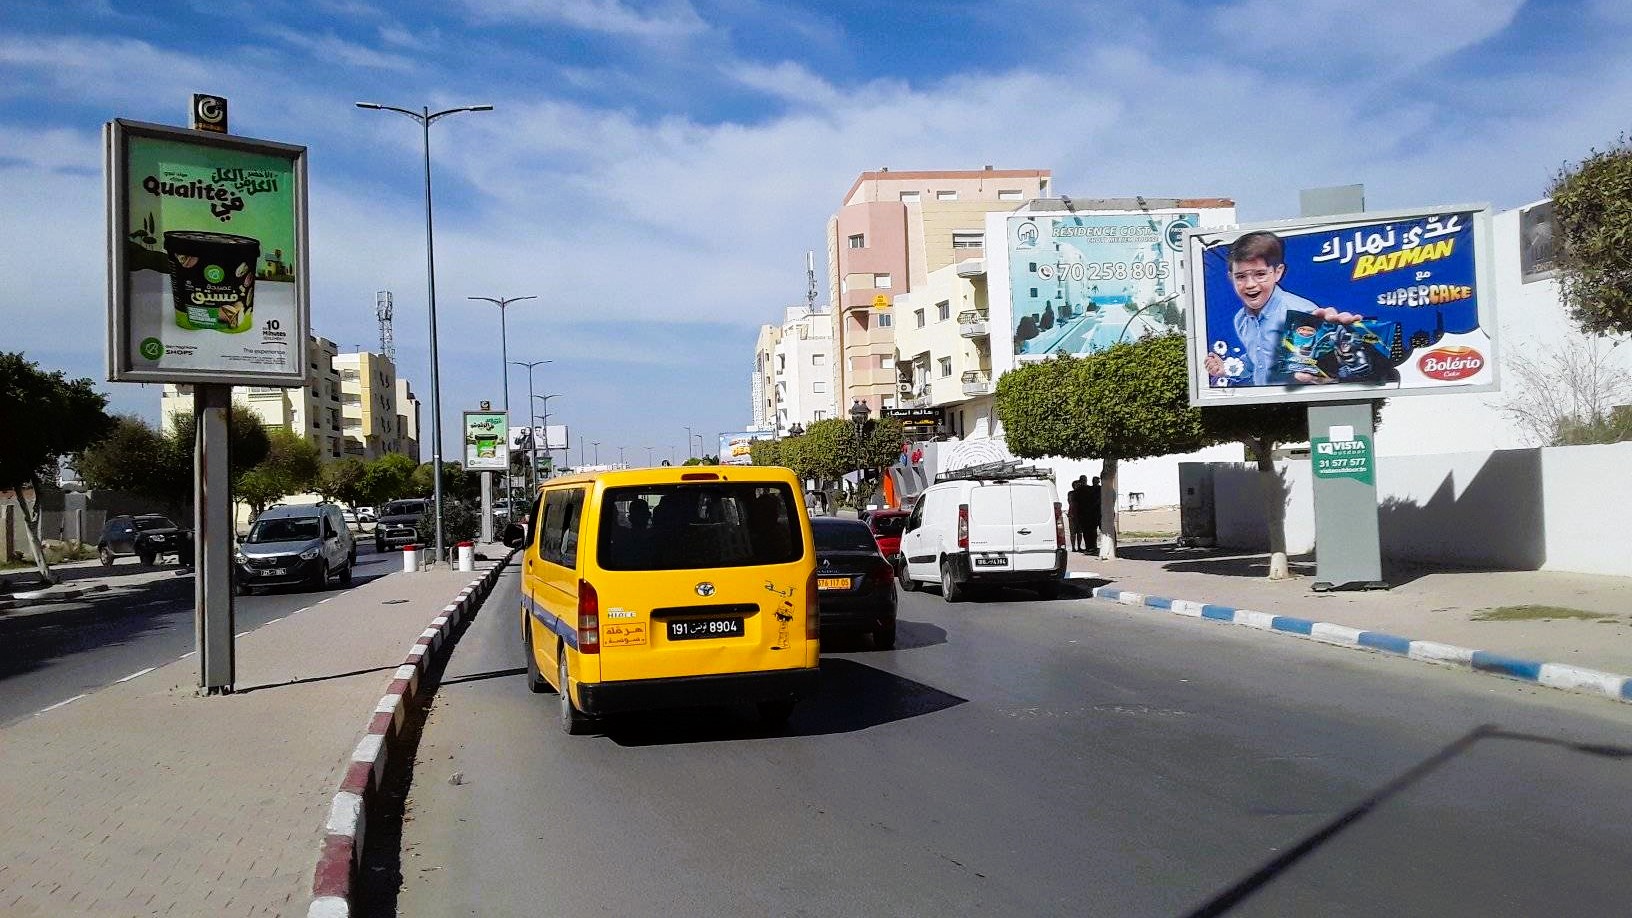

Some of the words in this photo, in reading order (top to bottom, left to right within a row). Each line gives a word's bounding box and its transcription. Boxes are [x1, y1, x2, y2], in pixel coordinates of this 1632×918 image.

[143, 175, 229, 201] Qualité
[211, 191, 244, 222] في
[1313, 225, 1395, 264] نهارك
[1352, 238, 1455, 280] BATMAN
[1058, 263, 1084, 281] 70
[1088, 262, 1127, 281] 258
[1131, 261, 1170, 281] 805
[1415, 271, 1431, 281] مع
[191, 287, 239, 304] فستق
[266, 319, 280, 330] 10
[1424, 357, 1480, 373] Bolério
[1333, 441, 1366, 450] VISTA
[1332, 459, 1347, 467] 577
[1349, 458, 1366, 466] 577
[672, 623, 688, 634] 191
[690, 622, 707, 634] تونس
[709, 621, 737, 633] 8904
